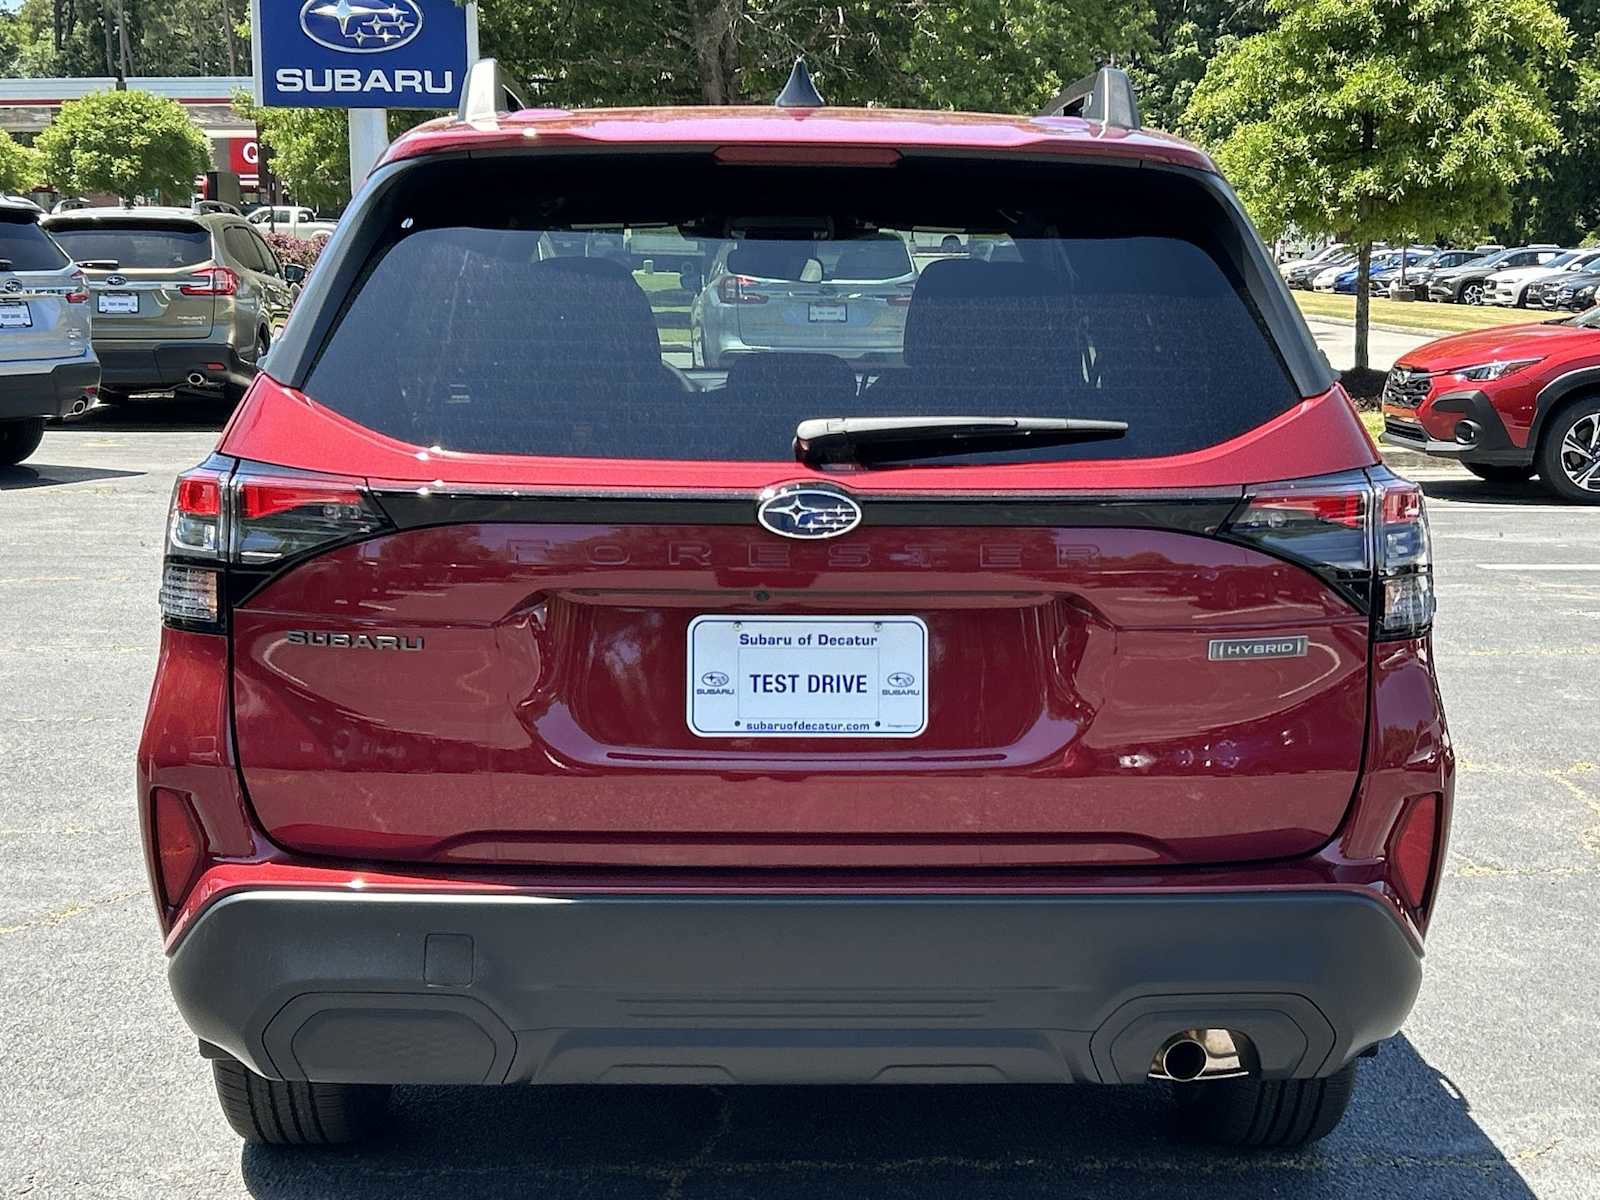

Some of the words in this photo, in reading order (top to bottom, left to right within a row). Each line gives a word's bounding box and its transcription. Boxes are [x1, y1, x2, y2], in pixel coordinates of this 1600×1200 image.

[275, 68, 453, 94] SUBARU
[506, 540, 1100, 568] FORESTER
[287, 630, 425, 652] SUBARU
[739, 633, 792, 646] Subaru
[798, 634, 812, 646] of
[818, 634, 878, 647] Decatur
[1227, 643, 1294, 655] HYBRID
[749, 674, 800, 694] TEST
[808, 674, 868, 694] DRIVE
[746, 720, 870, 731] subaruofdecatur.com
